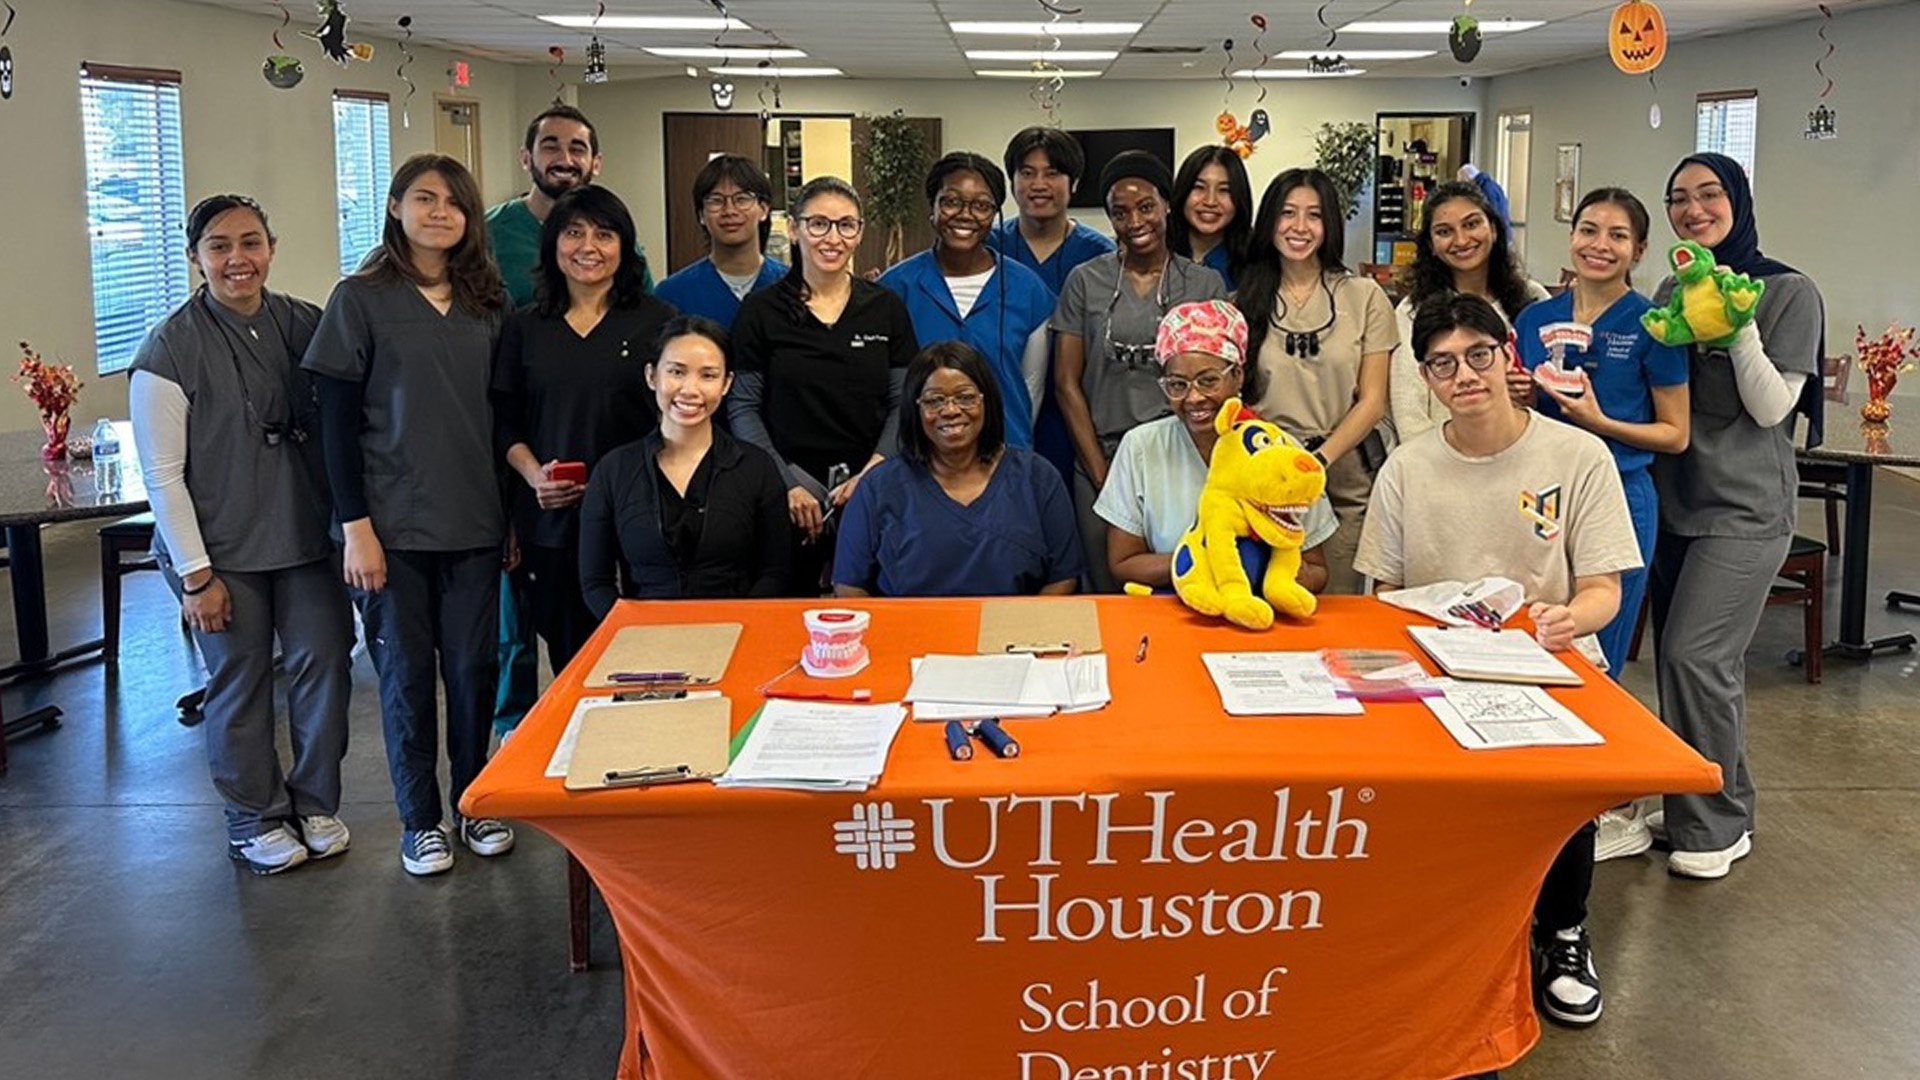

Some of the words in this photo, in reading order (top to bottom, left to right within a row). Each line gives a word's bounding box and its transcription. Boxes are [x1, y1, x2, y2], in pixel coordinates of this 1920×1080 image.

[922, 787, 1369, 868] UTHealth
[974, 873, 1323, 942] Houston
[1019, 974, 1206, 1033] School
[1222, 967, 1288, 1020] of
